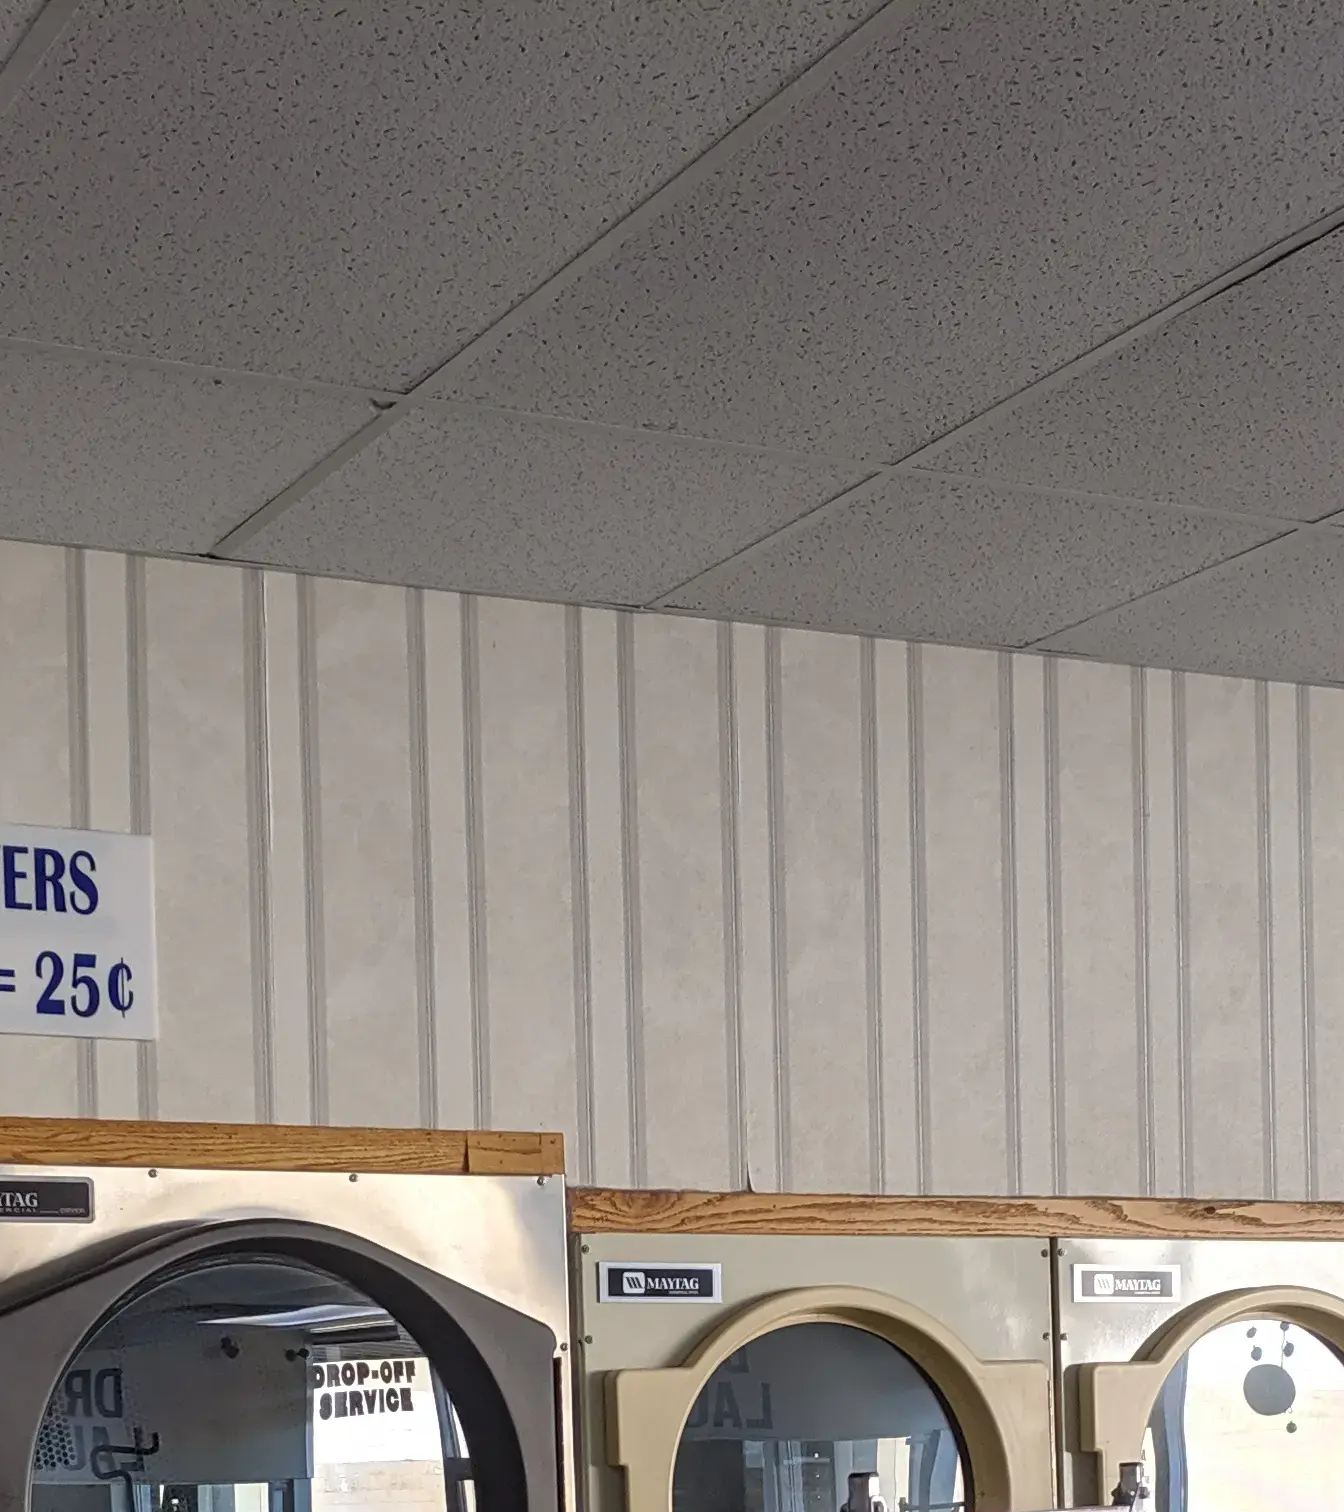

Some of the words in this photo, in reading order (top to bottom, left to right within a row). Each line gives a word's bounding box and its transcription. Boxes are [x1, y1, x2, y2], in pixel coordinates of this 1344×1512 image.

[35, 951, 134, 1018] 25¢
[647, 1277, 699, 1289] MAYTAG
[1114, 1278, 1161, 1292] MAYTAG
[313, 1360, 415, 1389] DROP-OFF
[319, 1387, 414, 1420] SERVICE
